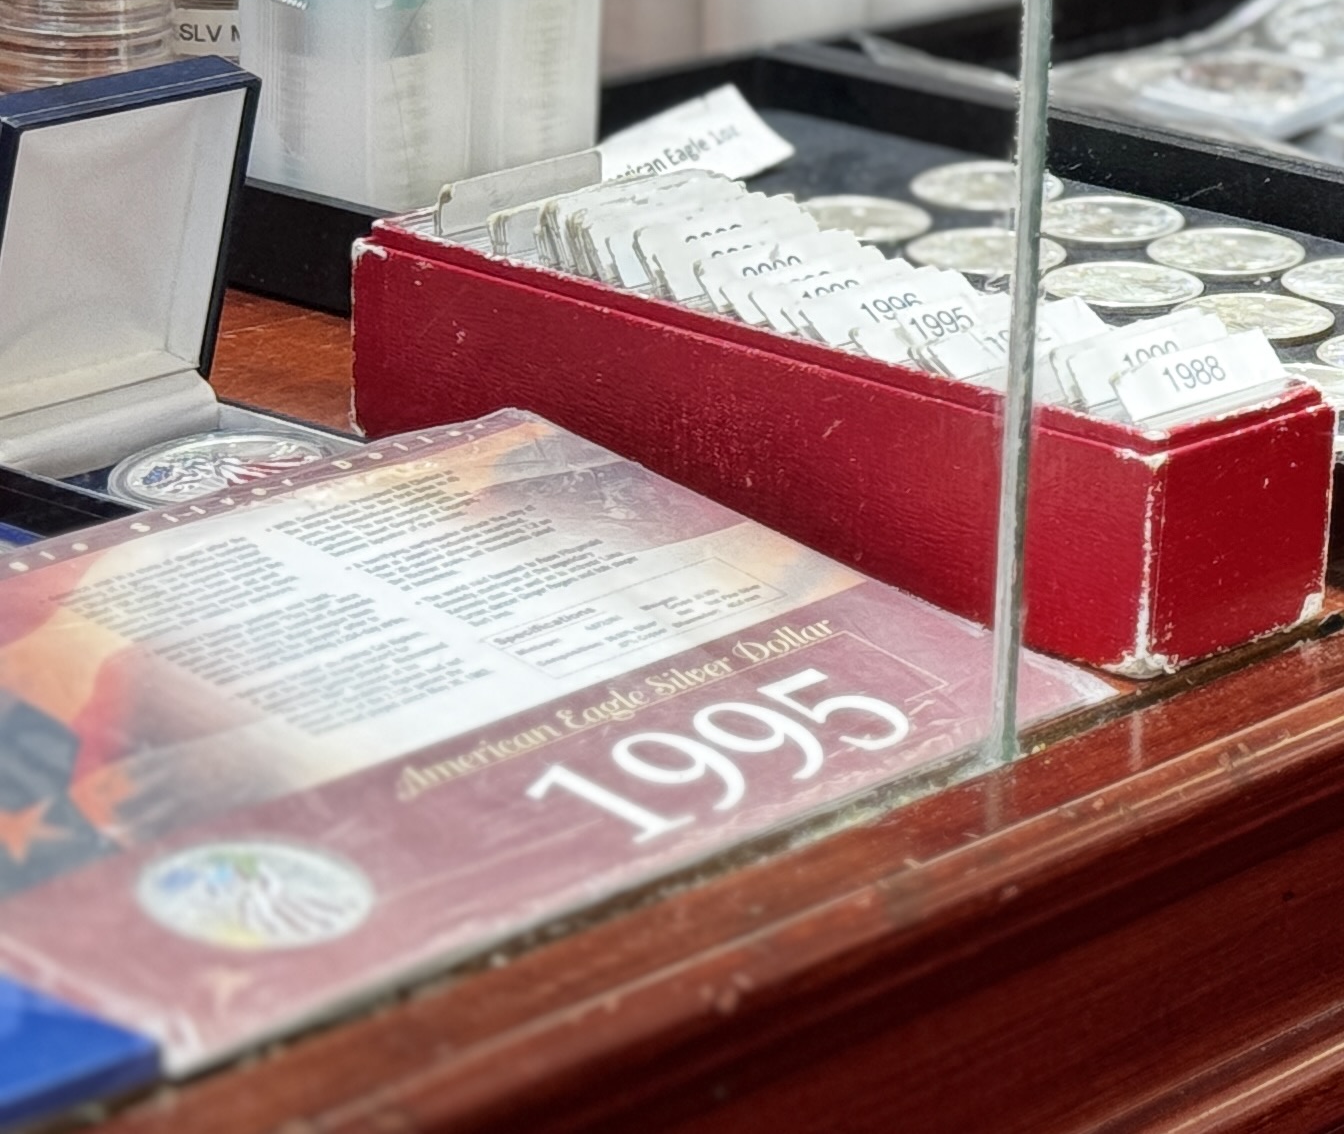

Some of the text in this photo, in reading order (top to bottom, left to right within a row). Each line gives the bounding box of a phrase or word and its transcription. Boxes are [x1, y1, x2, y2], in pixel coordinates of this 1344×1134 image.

[179, 23, 222, 43] SLV
[663, 138, 710, 167] Eagle
[909, 306, 974, 340] 1995
[1162, 355, 1226, 392] 1988
[398, 617, 835, 800] American Eagle Silver Dollar
[525, 668, 910, 845] 1995
